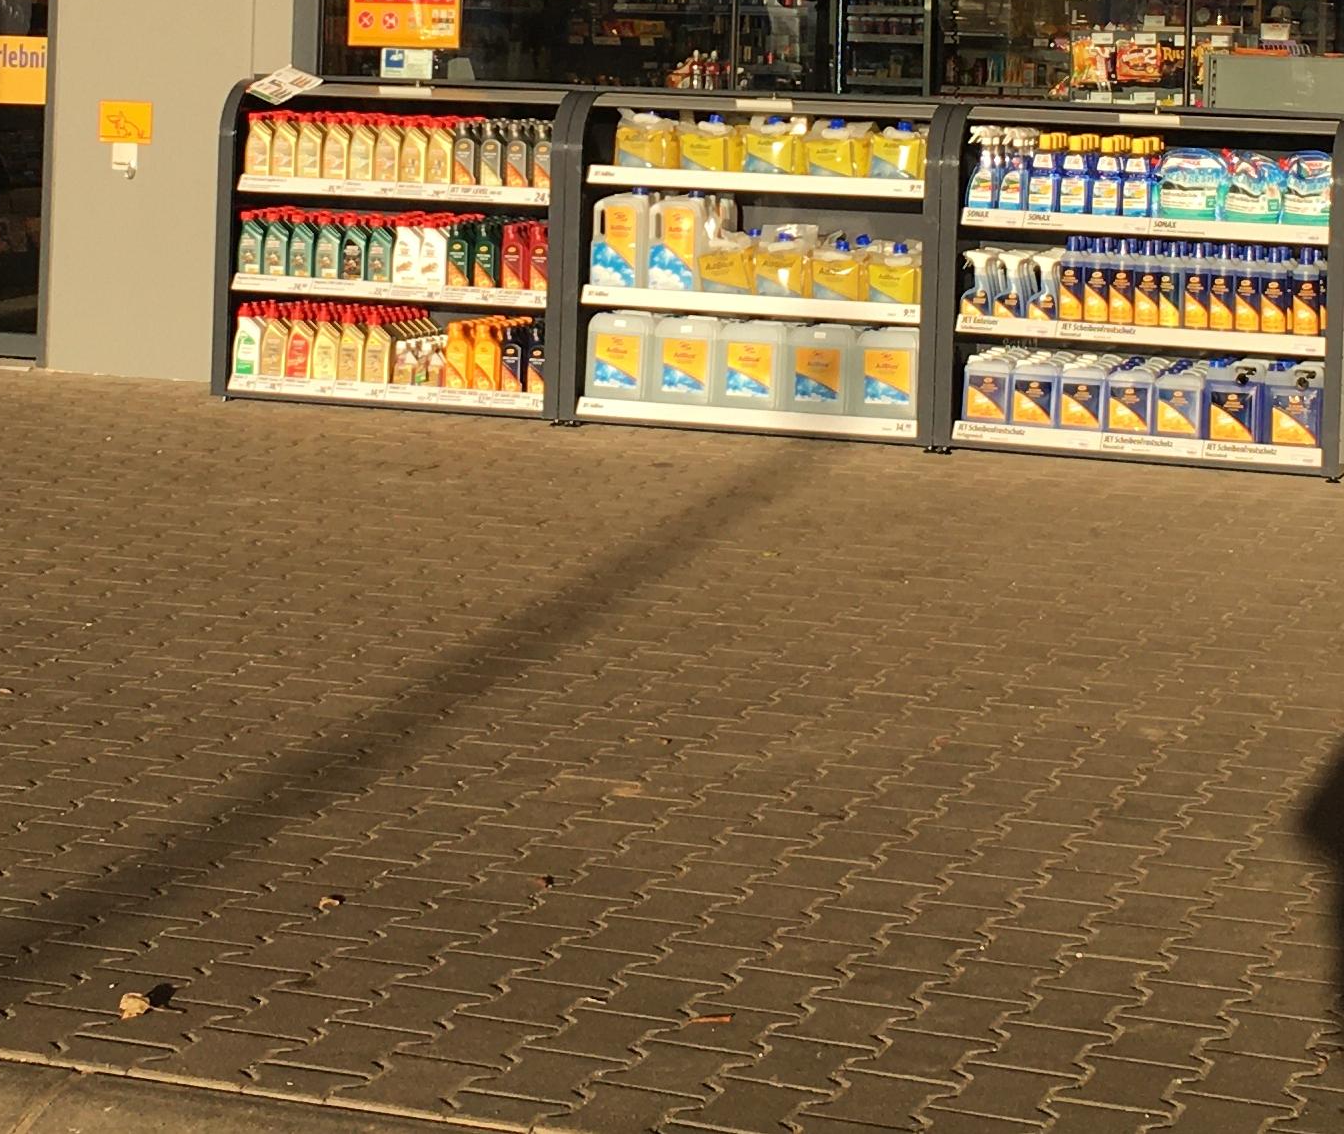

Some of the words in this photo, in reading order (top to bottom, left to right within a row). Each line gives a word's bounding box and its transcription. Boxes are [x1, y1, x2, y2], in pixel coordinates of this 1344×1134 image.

[966, 210, 990, 220] SONAX
[1027, 213, 1051, 222] SONAX
[1153, 220, 1177, 230] SONAX
[961, 316, 972, 324] JET
[1061, 323, 1072, 331] JET
[1073, 324, 1137, 335] Scheibenfrostschutz
[958, 423, 968, 431] JET
[968, 424, 1025, 436] Scheibenfrostschutz
[1104, 435, 1115, 443] JET
[1115, 435, 1174, 448] Scheibenfrostschutz
[1206, 443, 1217, 451] JET
[1218, 443, 1277, 456] Scheibenfrostschutz
